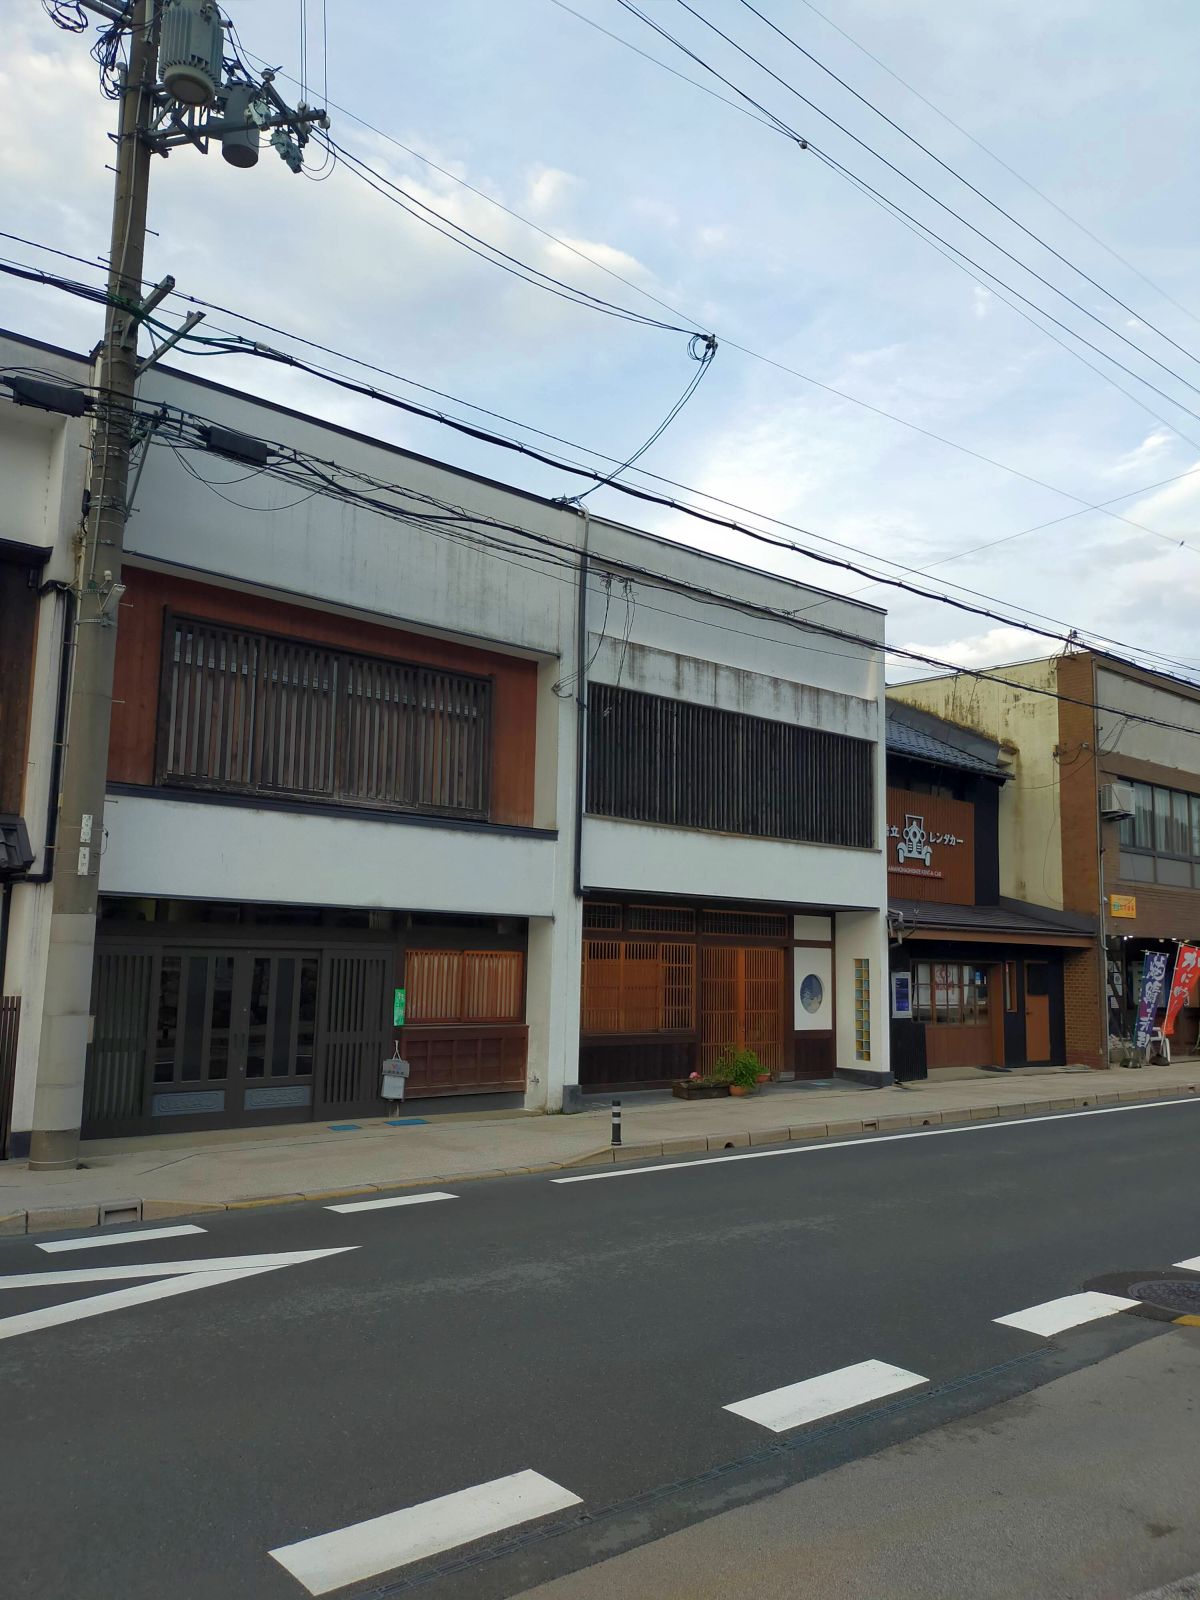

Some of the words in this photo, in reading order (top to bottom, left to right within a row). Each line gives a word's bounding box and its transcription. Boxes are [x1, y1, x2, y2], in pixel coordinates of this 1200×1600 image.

[930, 832, 964, 846] レンタカー
